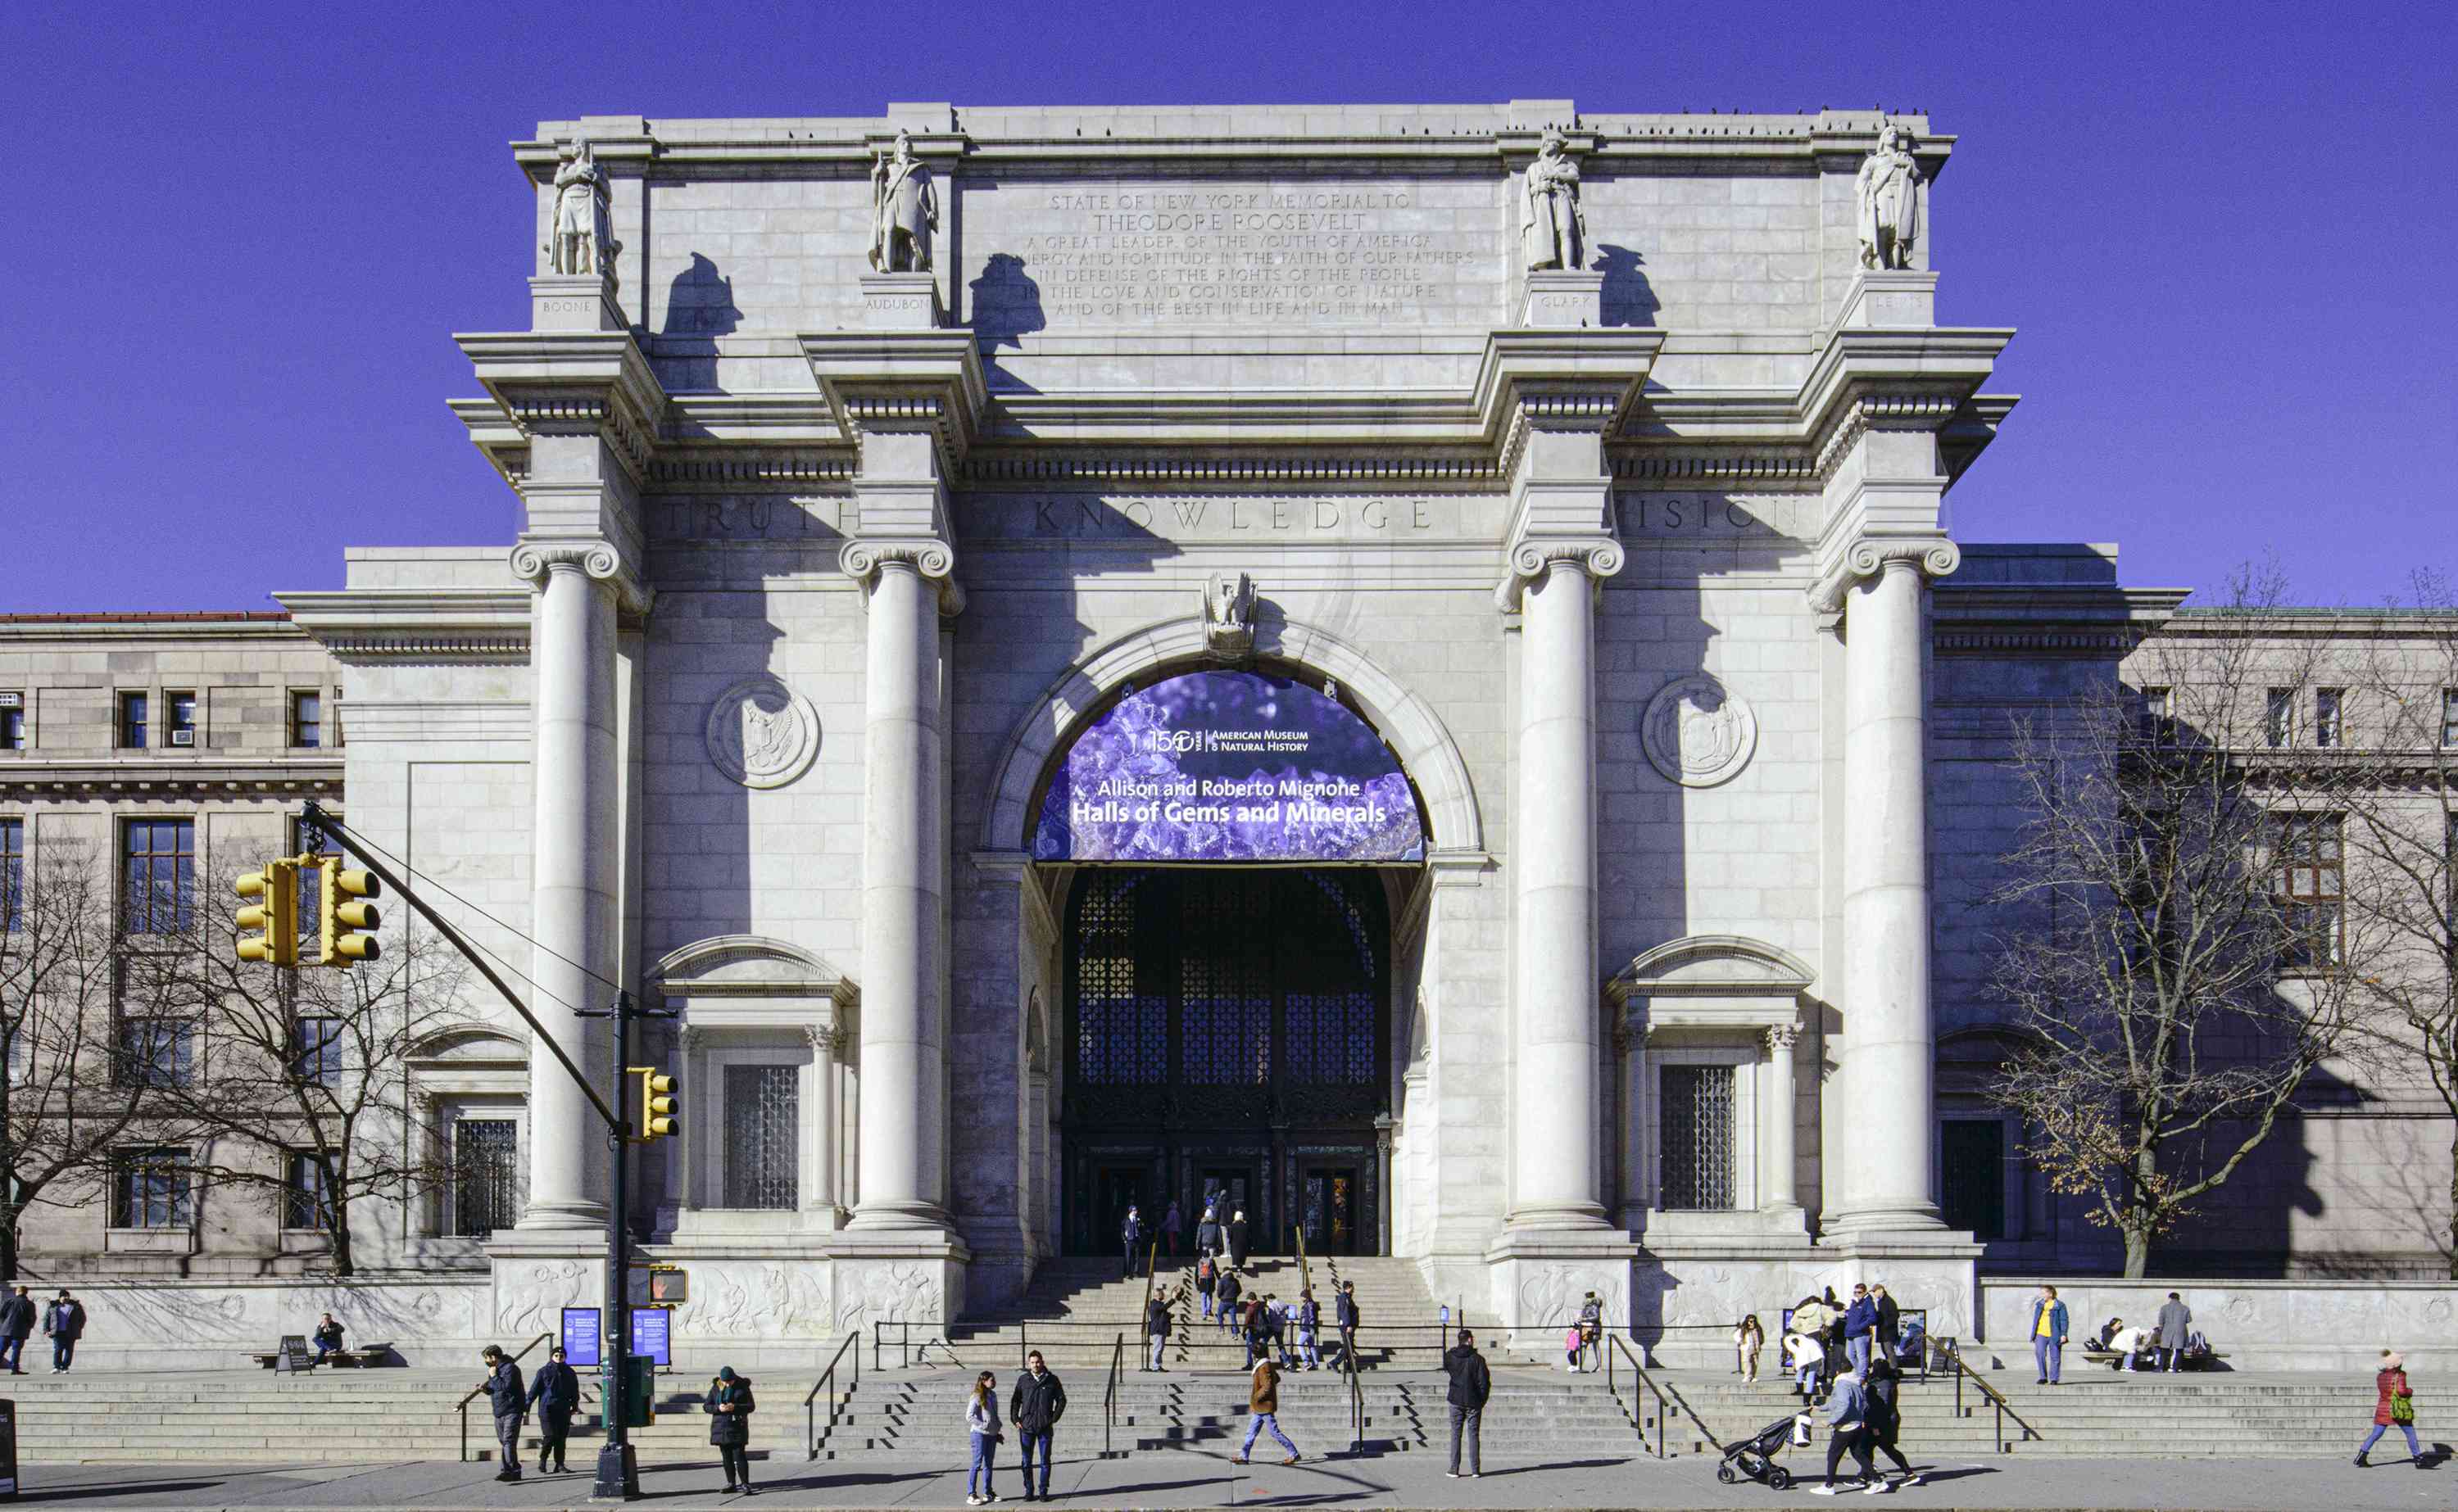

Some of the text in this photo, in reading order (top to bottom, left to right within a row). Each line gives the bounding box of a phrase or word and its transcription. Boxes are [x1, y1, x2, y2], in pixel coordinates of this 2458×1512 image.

[1050, 193, 1410, 211] STATE OF NEW YORK MEMORIAL TO
[1094, 213, 1367, 232] THEODORE ROOSEVELT
[1027, 235, 1431, 250] A GREAT LEADER OF THE YOUTH OF AMERICA
[1079, 254, 1113, 266] AND
[1122, 252, 1213, 265] FORTITUDE
[1221, 252, 1236, 265] IN
[1244, 251, 1274, 265] THE
[1281, 251, 1327, 265] FAITH
[1336, 251, 1357, 265] OF
[1363, 251, 1400, 265] OUR
[1406, 251, 1475, 264] FATHERS
[1039, 269, 1422, 283] IN DEFENSE OF THE RIGHTS OF THE PEOPLE
[1050, 287, 1082, 299] THE
[1091, 286, 1136, 299] LOVE
[1144, 286, 1181, 298] AND
[1190, 285, 1326, 298] CONSERVATION
[1336, 285, 1358, 298] OF
[1366, 284, 1436, 298] NATURE
[543, 301, 591, 313] BOONE
[865, 299, 929, 310] AUDUBON
[1056, 302, 1403, 316] AND OF THE BEST IN LIFE AND IN MAN
[662, 502, 860, 531] TRUTH
[1034, 500, 1431, 531] KNOWLEDGE
[1097, 779, 1359, 801] Allison and Roberto Mignone
[1073, 801, 1385, 822] Halls of Gems and Minerals
